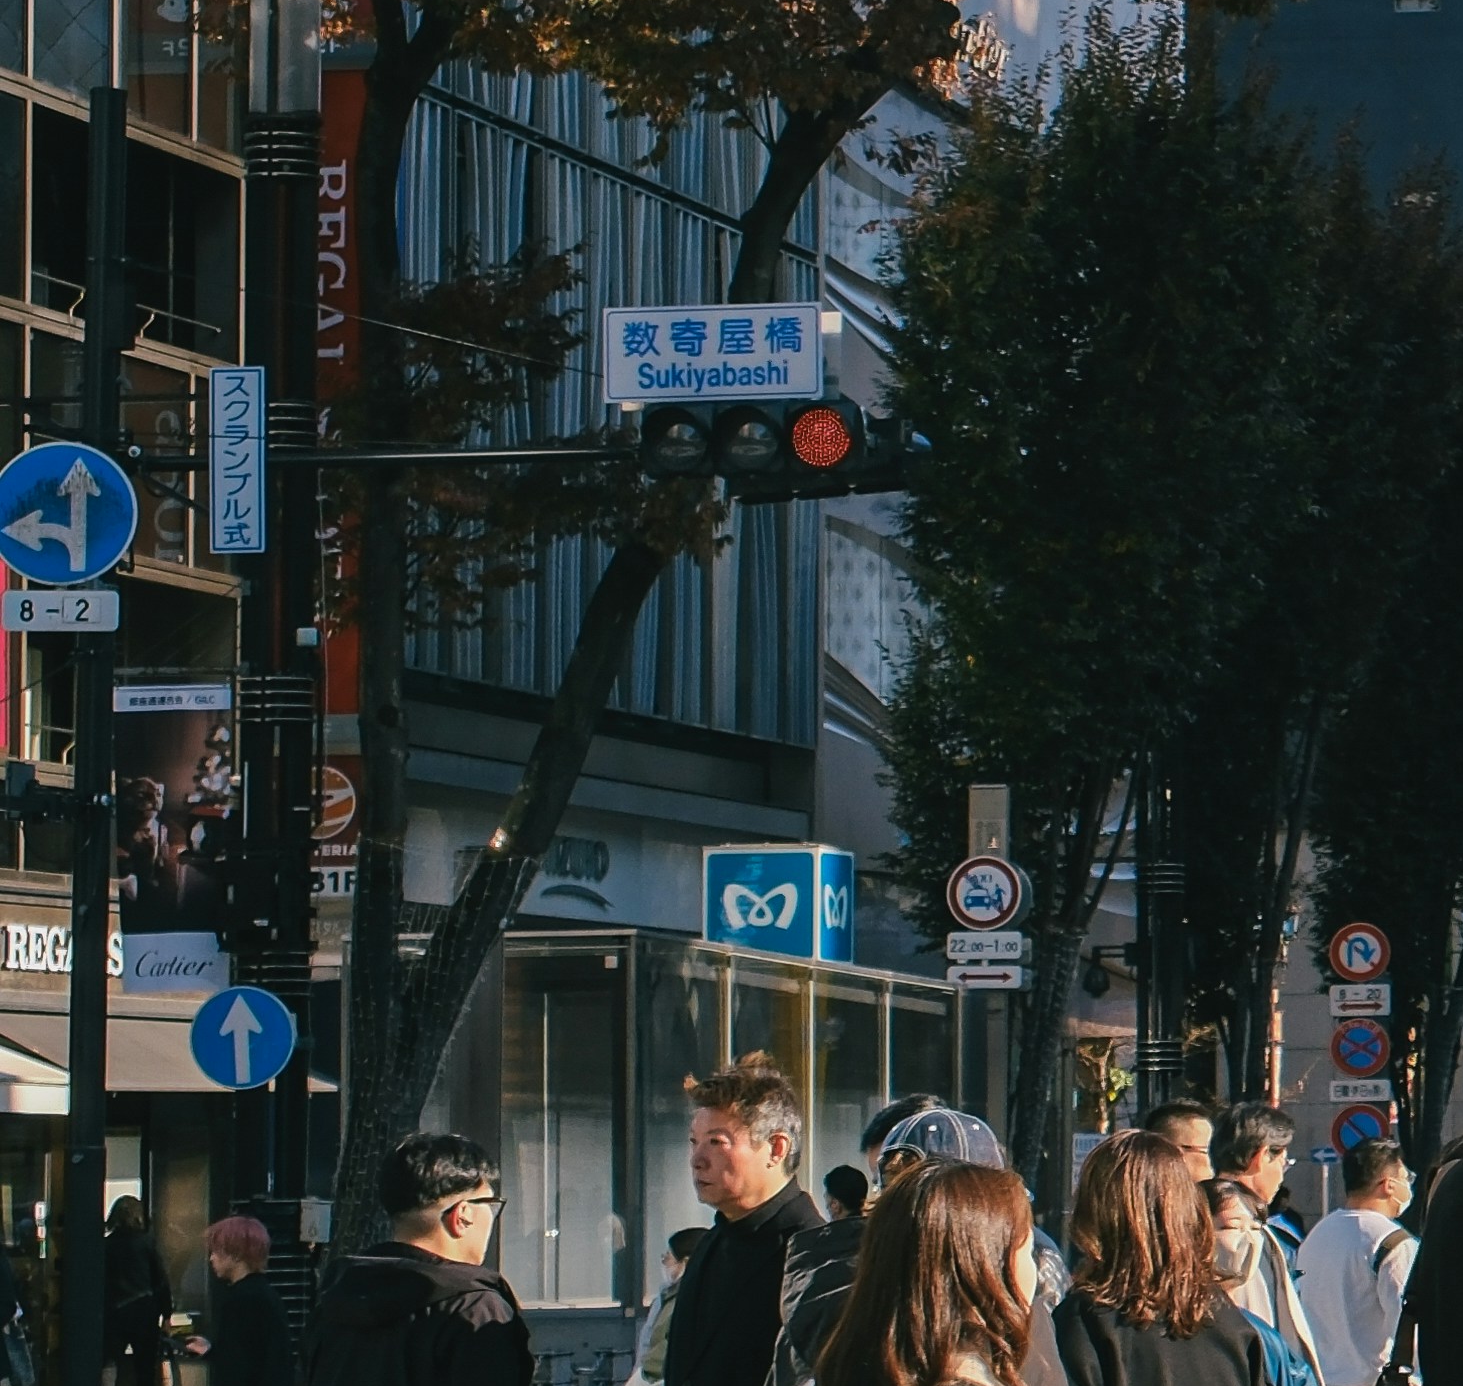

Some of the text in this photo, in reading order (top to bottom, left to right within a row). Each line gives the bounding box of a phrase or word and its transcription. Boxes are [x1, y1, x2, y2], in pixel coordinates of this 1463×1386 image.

[622, 316, 804, 358] 数寄屋橋
[637, 359, 789, 393] Sukiyabashi
[6, 924, 73, 972] REG
[135, 950, 215, 978] Cartier
